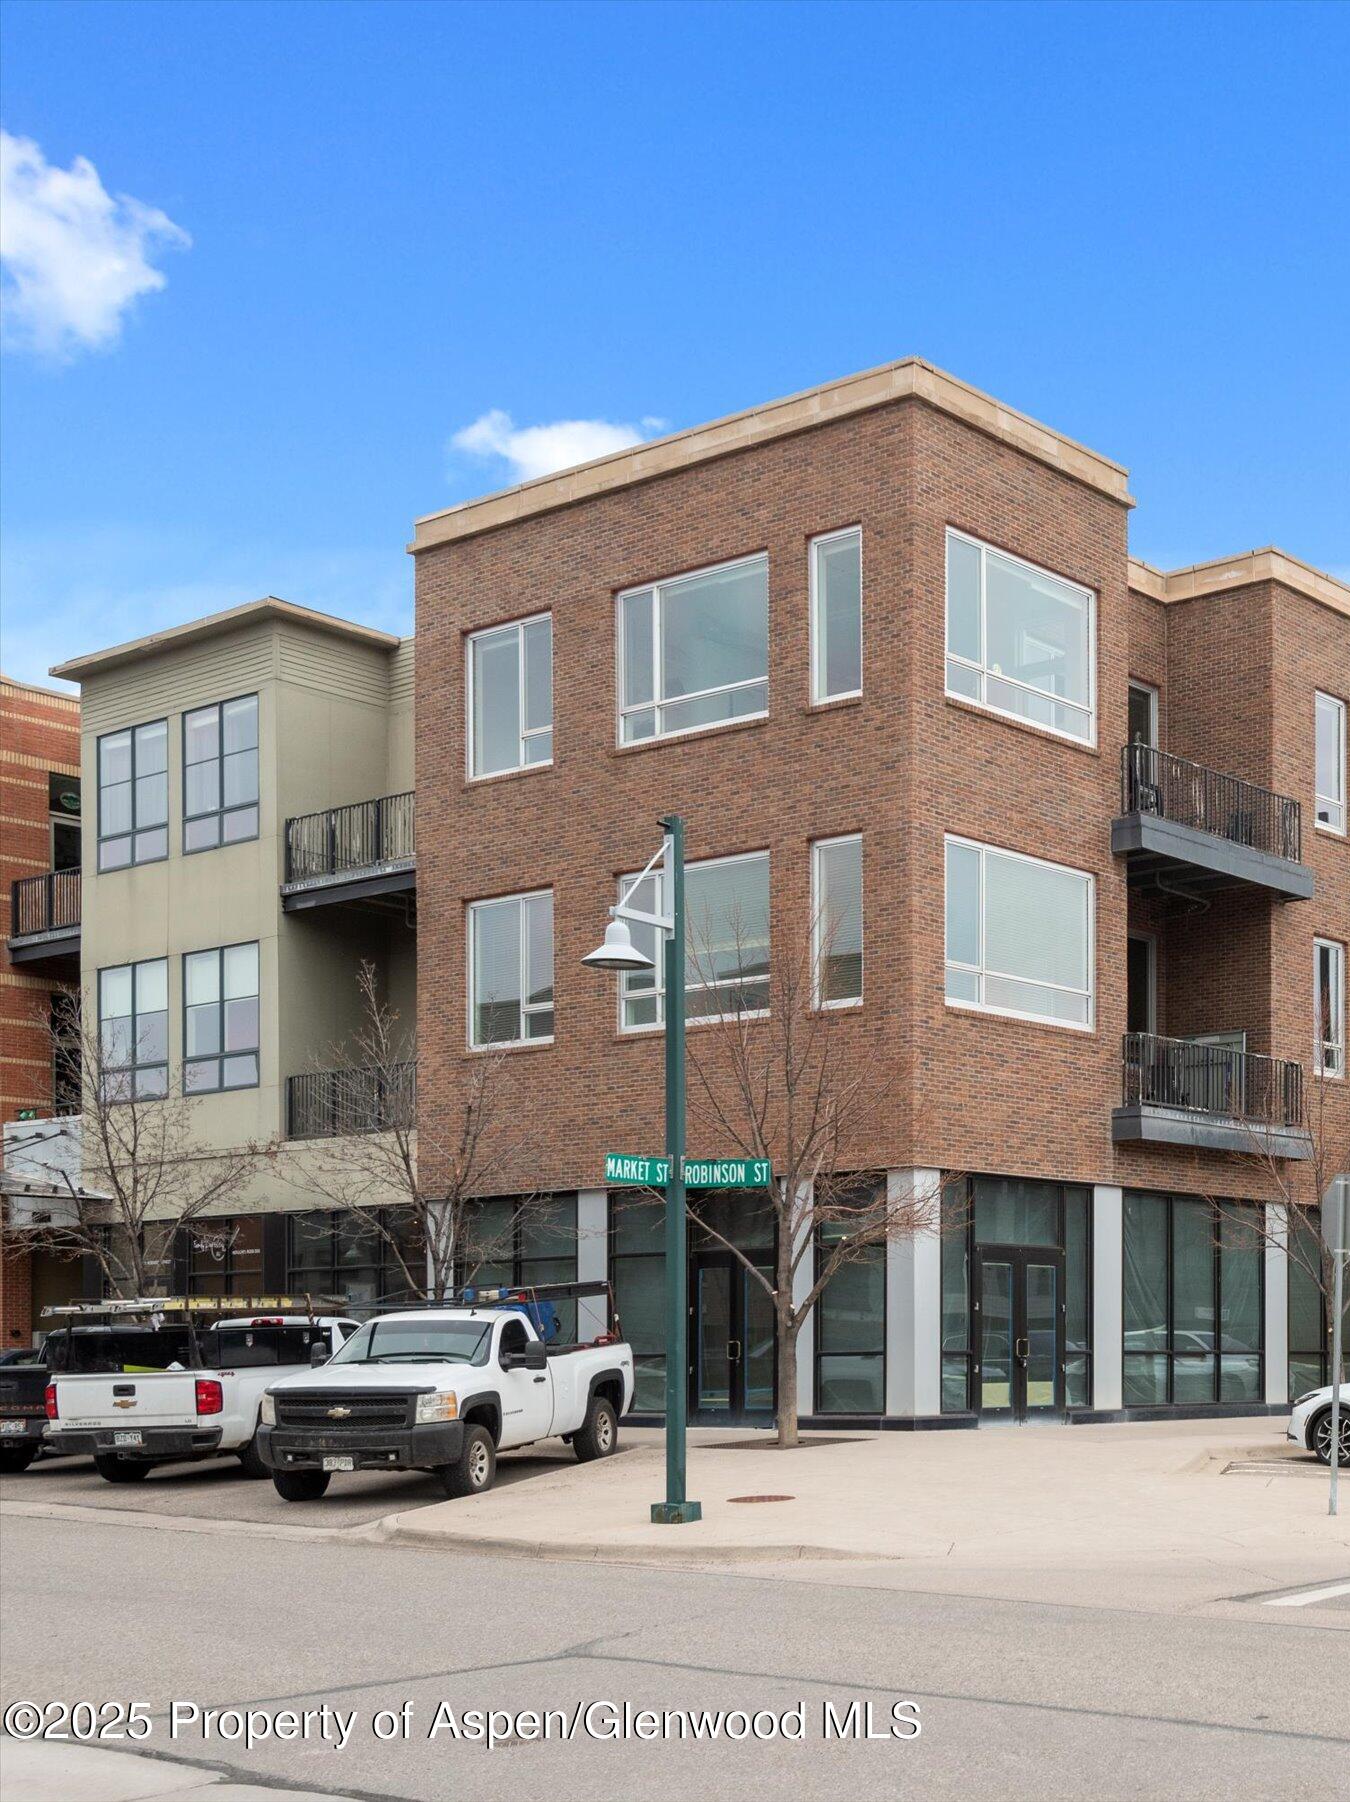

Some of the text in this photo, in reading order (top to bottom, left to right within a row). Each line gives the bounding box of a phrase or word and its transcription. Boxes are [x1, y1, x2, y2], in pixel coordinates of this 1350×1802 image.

[607, 1157, 669, 1183] MARKET ST
[685, 1162, 768, 1184] ROBINSON ST
